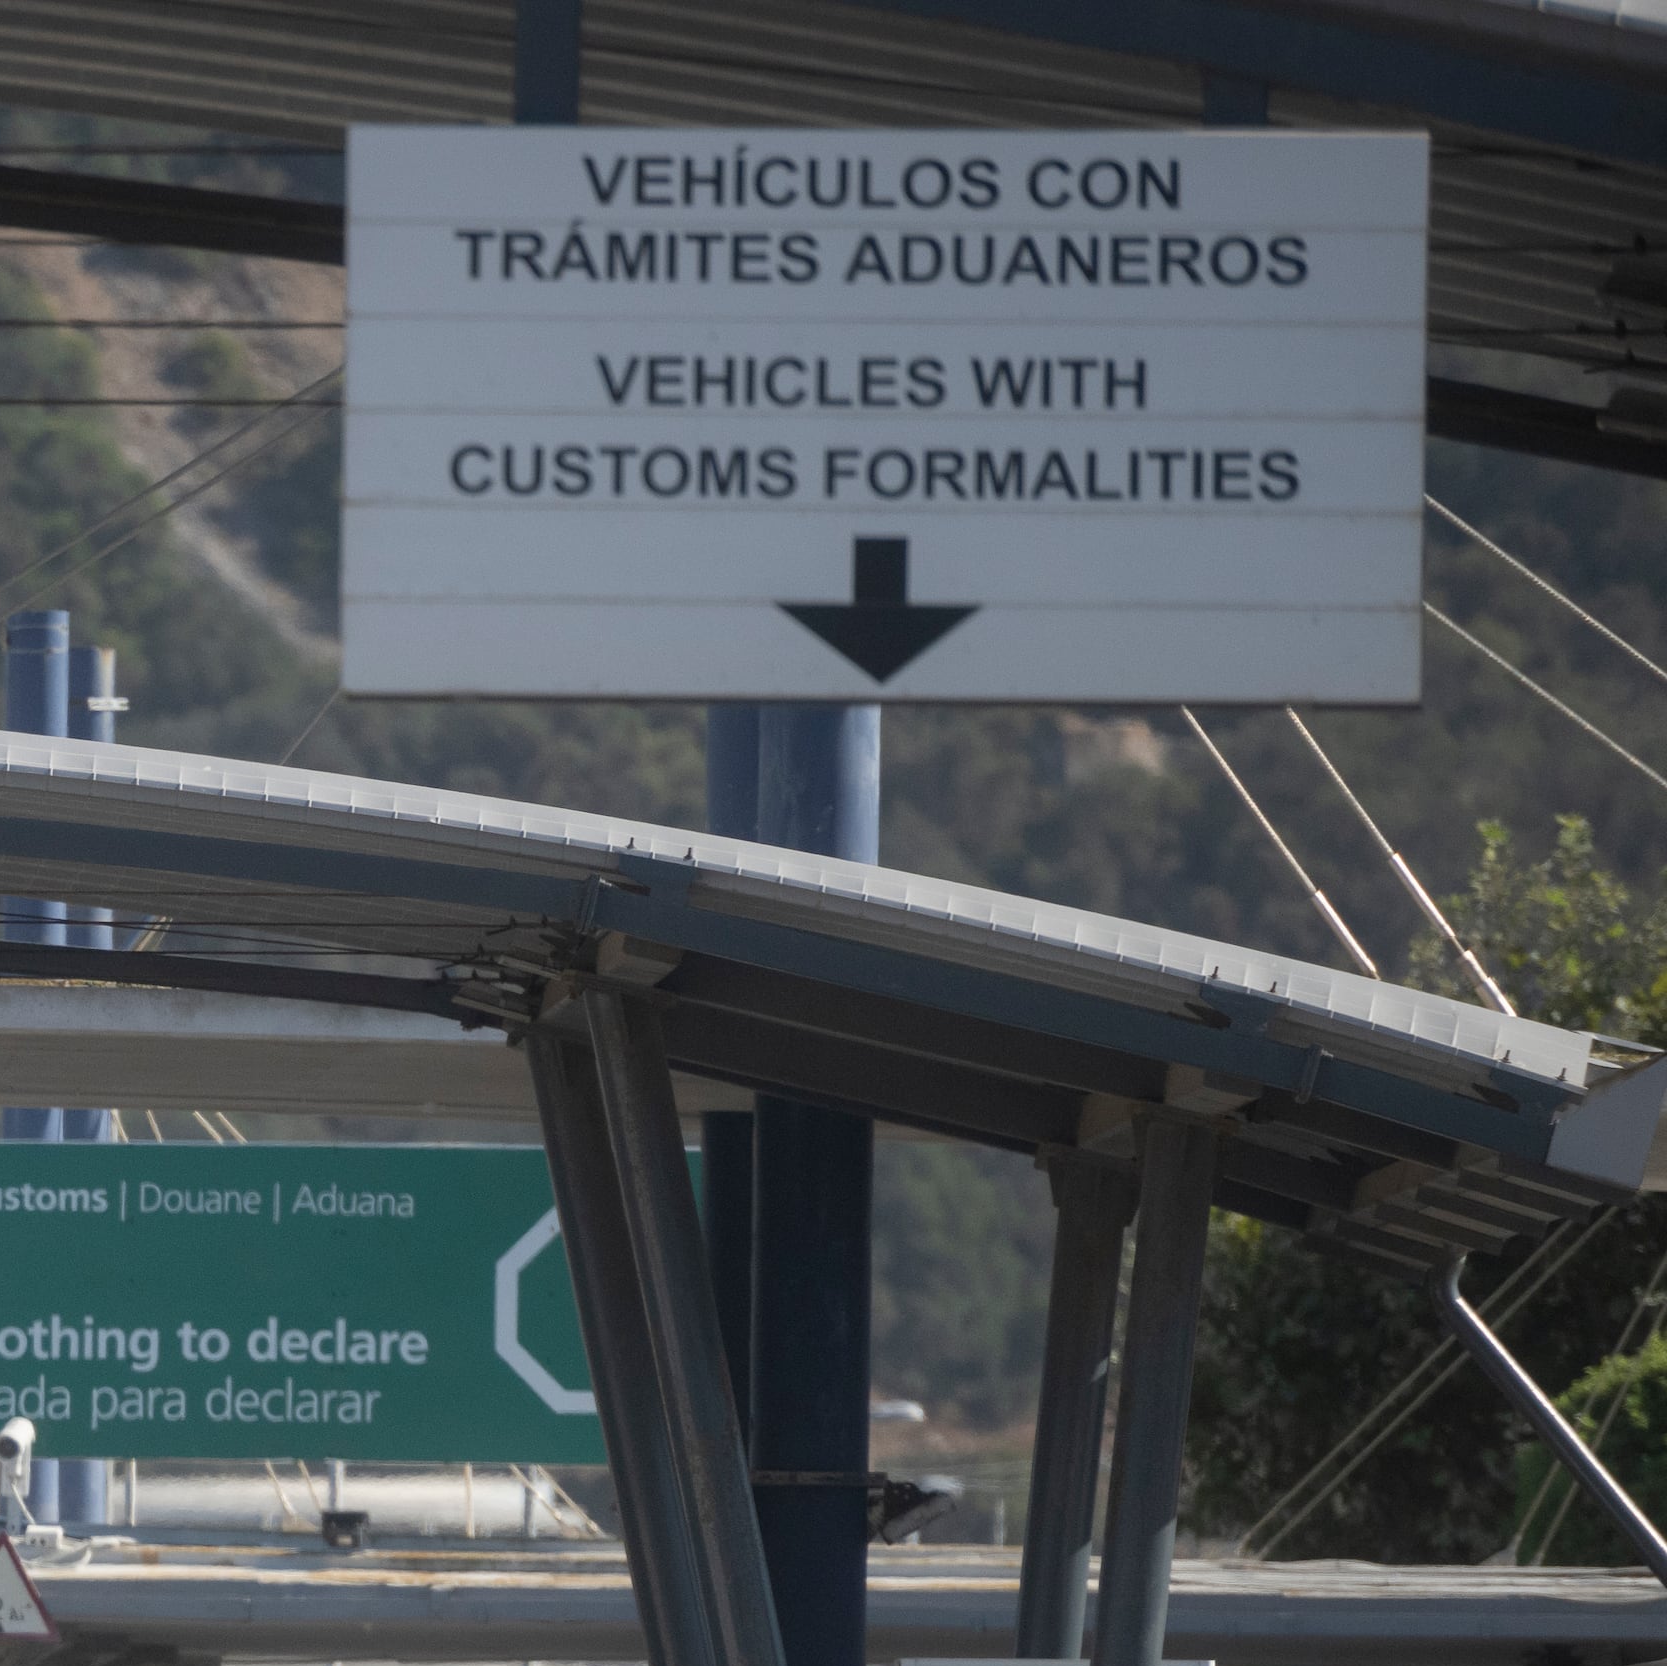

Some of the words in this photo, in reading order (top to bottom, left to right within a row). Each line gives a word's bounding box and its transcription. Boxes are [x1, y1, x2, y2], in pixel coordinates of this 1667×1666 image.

[584, 146, 1000, 208] VEHÍCULOS
[1025, 159, 1181, 210] CON
[454, 219, 818, 284] TRÁMITES
[843, 236, 1309, 287] ADUANEROS
[595, 356, 946, 407] VEHICLES
[970, 358, 1148, 409] WITH
[449, 446, 797, 498] CUSTOMS
[825, 448, 1300, 501] FORMALITIES
[140, 1183, 261, 1214] Douane
[292, 1185, 414, 1218] Aduana
[178, 1323, 230, 1360] to
[247, 1317, 428, 1364] declare
[92, 1381, 186, 1429] para
[206, 1377, 380, 1424] declarar
